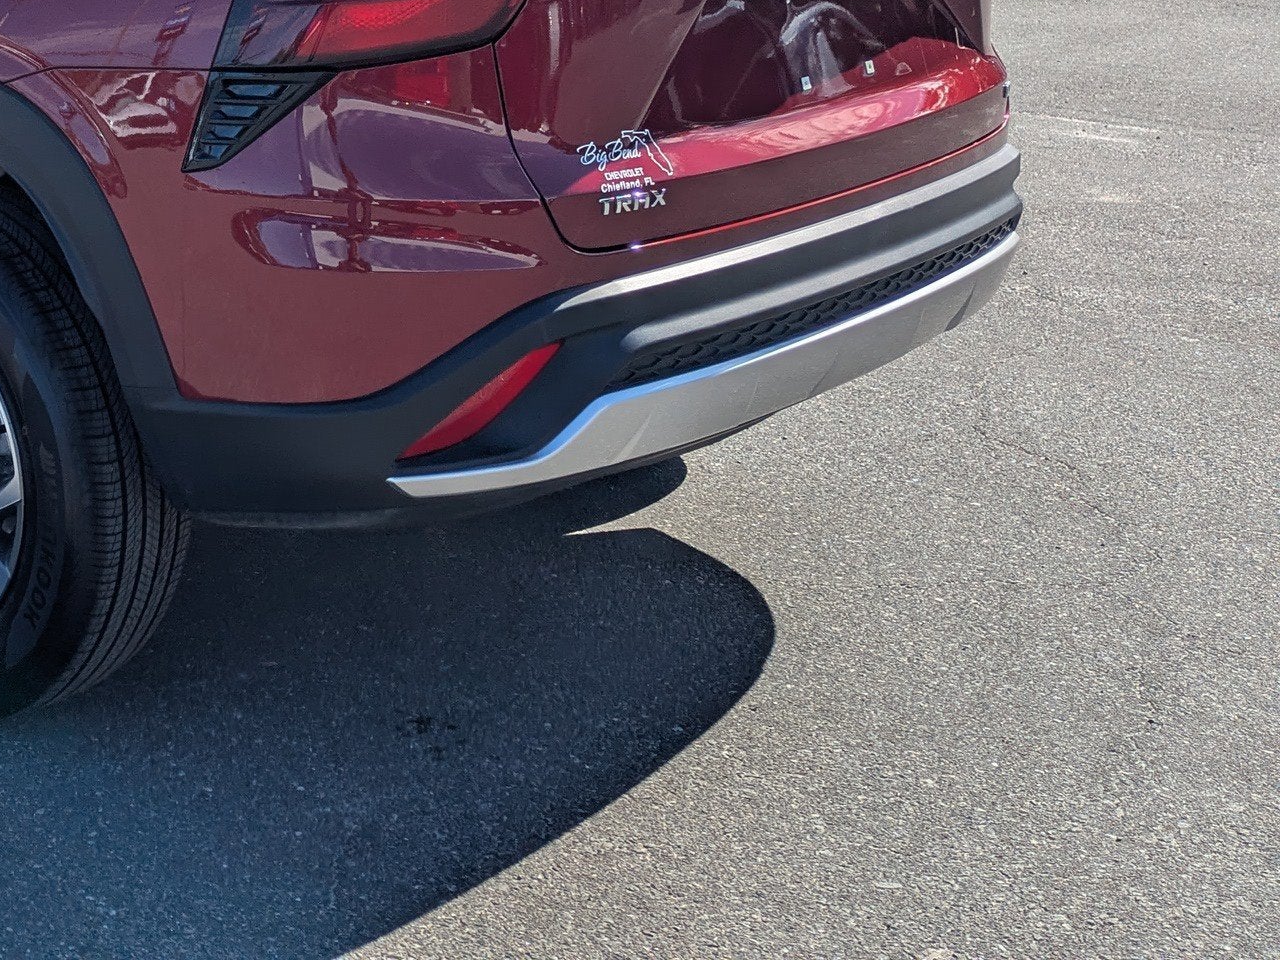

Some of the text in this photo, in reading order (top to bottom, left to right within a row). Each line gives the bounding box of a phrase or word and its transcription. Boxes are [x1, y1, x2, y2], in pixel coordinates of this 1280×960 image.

[576, 138, 642, 171] Big Bend
[600, 177, 655, 193] Chiefland, FL
[604, 167, 644, 181] CHEVROLET
[599, 188, 667, 216] TRAX
